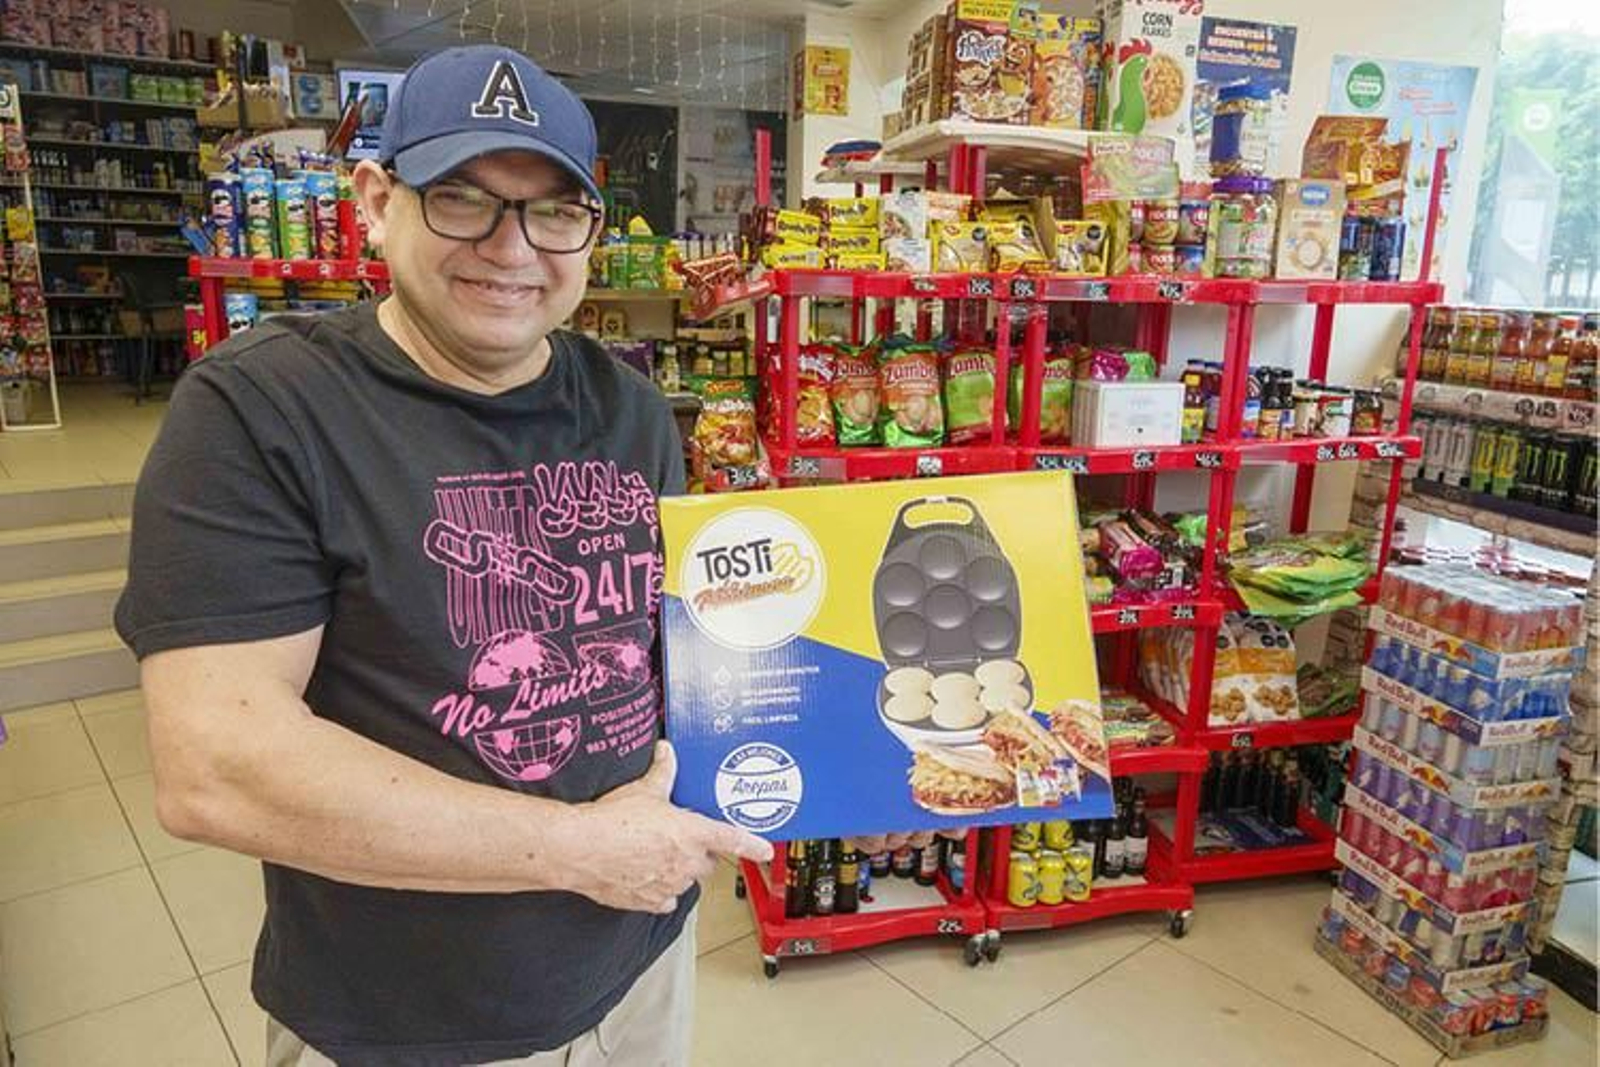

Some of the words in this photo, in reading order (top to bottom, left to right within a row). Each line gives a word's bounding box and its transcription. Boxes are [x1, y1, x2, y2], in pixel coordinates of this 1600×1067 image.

[1142, 11, 1173, 26] CORN
[471, 60, 539, 126] A
[578, 533, 626, 555] OPEN
[574, 551, 654, 626] 24/7
[432, 694, 496, 738] No
[500, 662, 609, 724] Limits
[731, 777, 788, 800] Arepas
